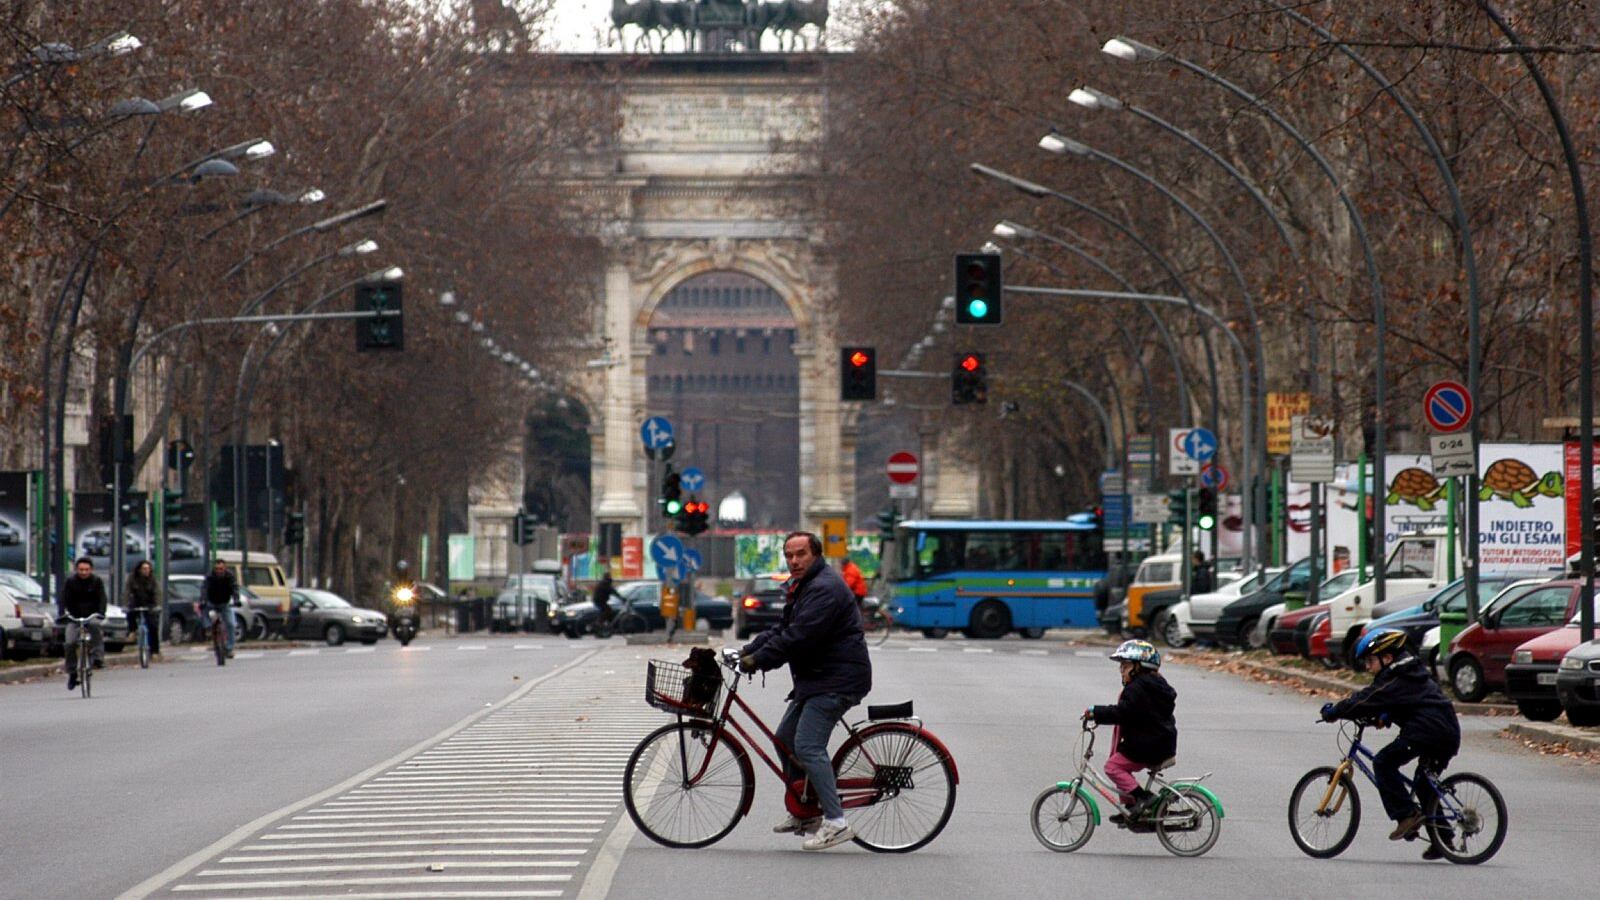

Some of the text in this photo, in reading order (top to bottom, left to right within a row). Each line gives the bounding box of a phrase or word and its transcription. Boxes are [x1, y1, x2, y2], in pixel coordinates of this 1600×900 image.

[1440, 440, 1463, 449] 0-24
[1491, 521, 1554, 532] INDIETRO
[1500, 532, 1521, 544] GLI
